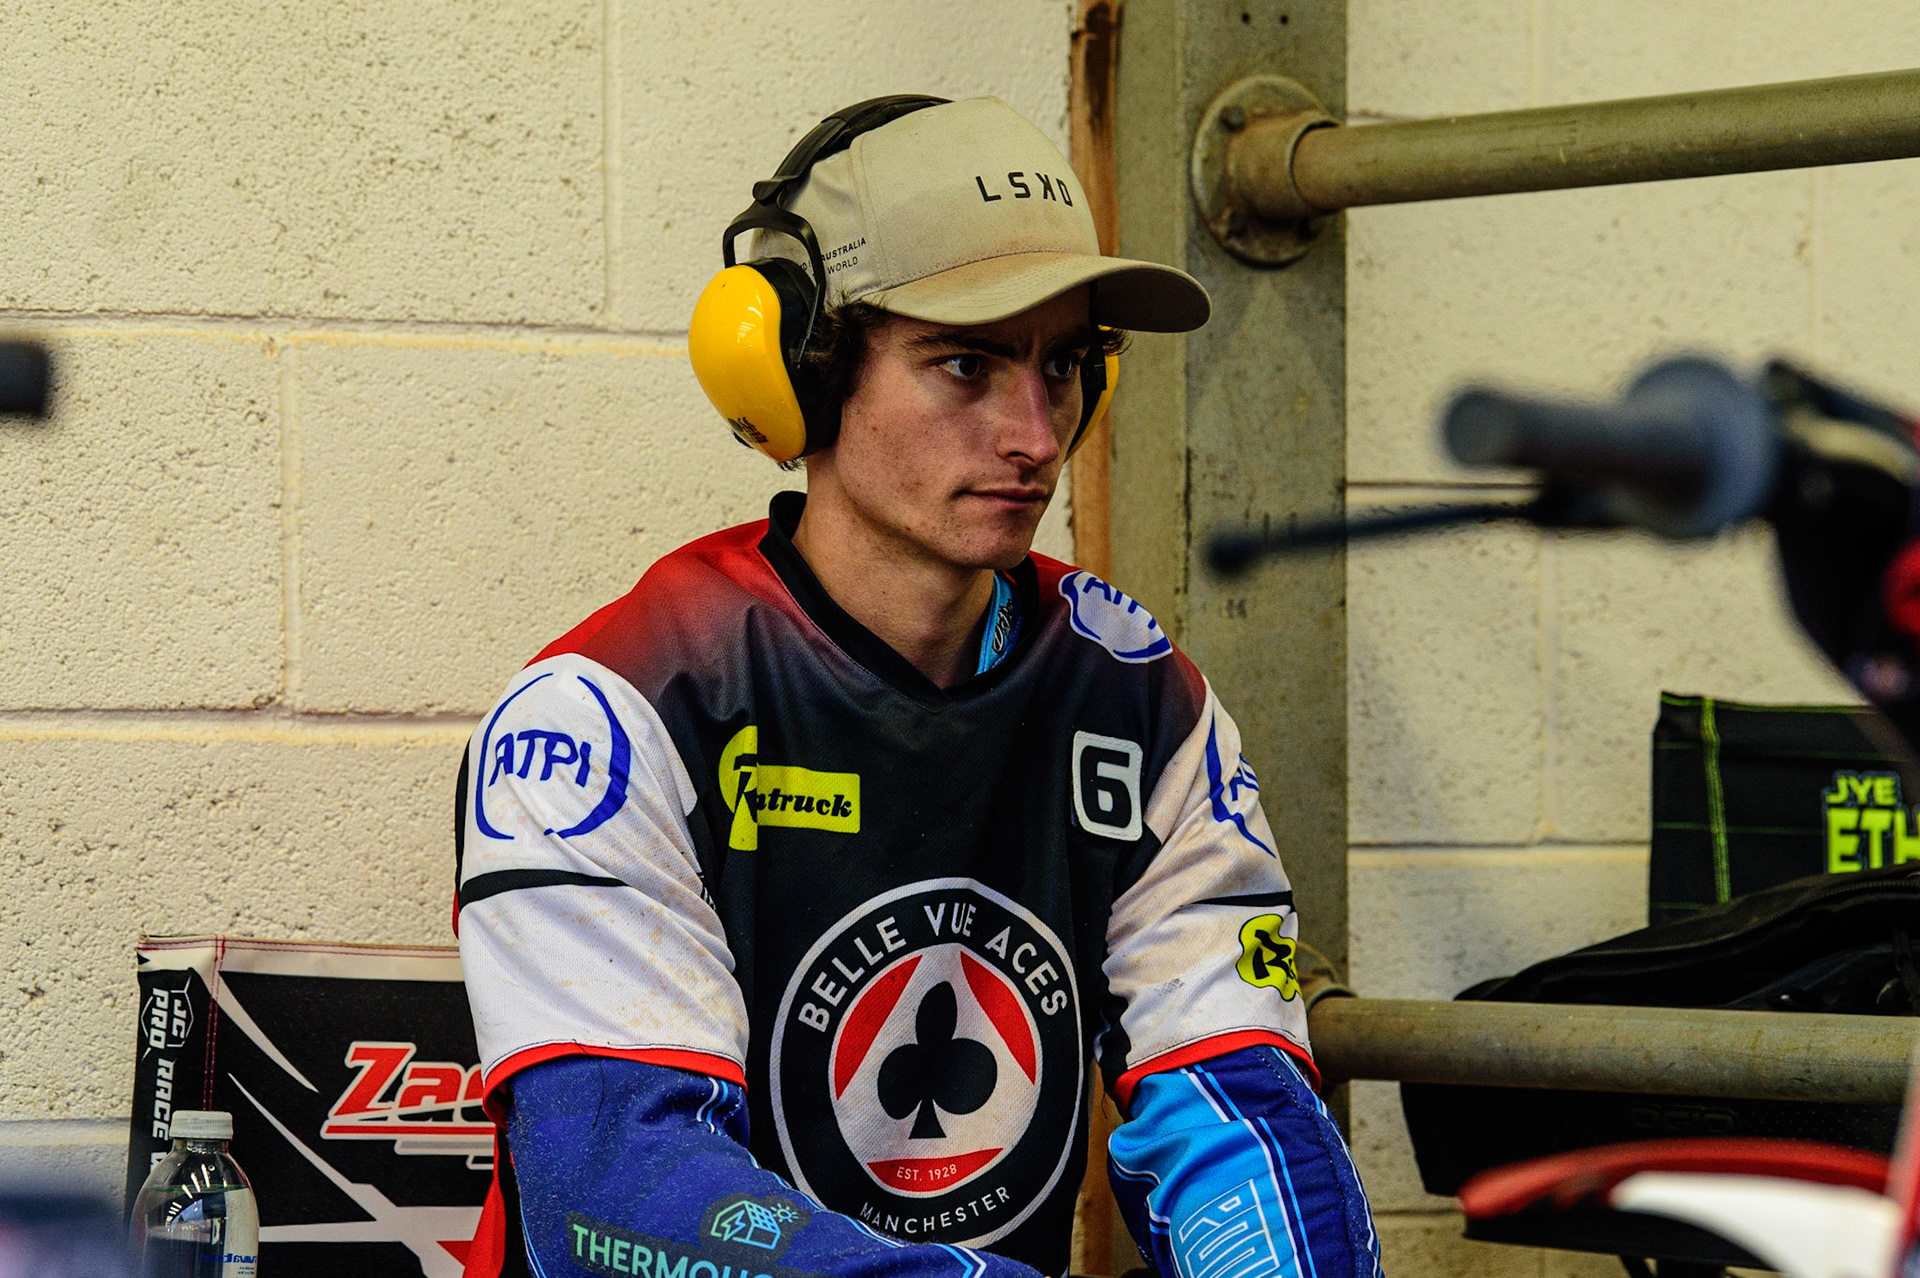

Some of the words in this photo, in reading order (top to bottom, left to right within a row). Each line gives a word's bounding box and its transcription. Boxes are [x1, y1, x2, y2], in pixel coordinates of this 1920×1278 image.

[820, 237, 866, 261] AUSTRALIA
[827, 256, 859, 275] WORLD
[488, 729, 591, 788] ATPI
[1080, 745, 1133, 829] 6
[1825, 775, 1897, 805] JYE
[798, 917, 906, 1033] BELLE
[924, 902, 976, 937] VUE
[985, 925, 1068, 1016] ACES
[148, 987, 170, 1050] PRO
[152, 1057, 175, 1142] RACE
[896, 1166, 922, 1182] EST.
[929, 1164, 958, 1181] 1928
[860, 1186, 1011, 1235] MANCHESTER
